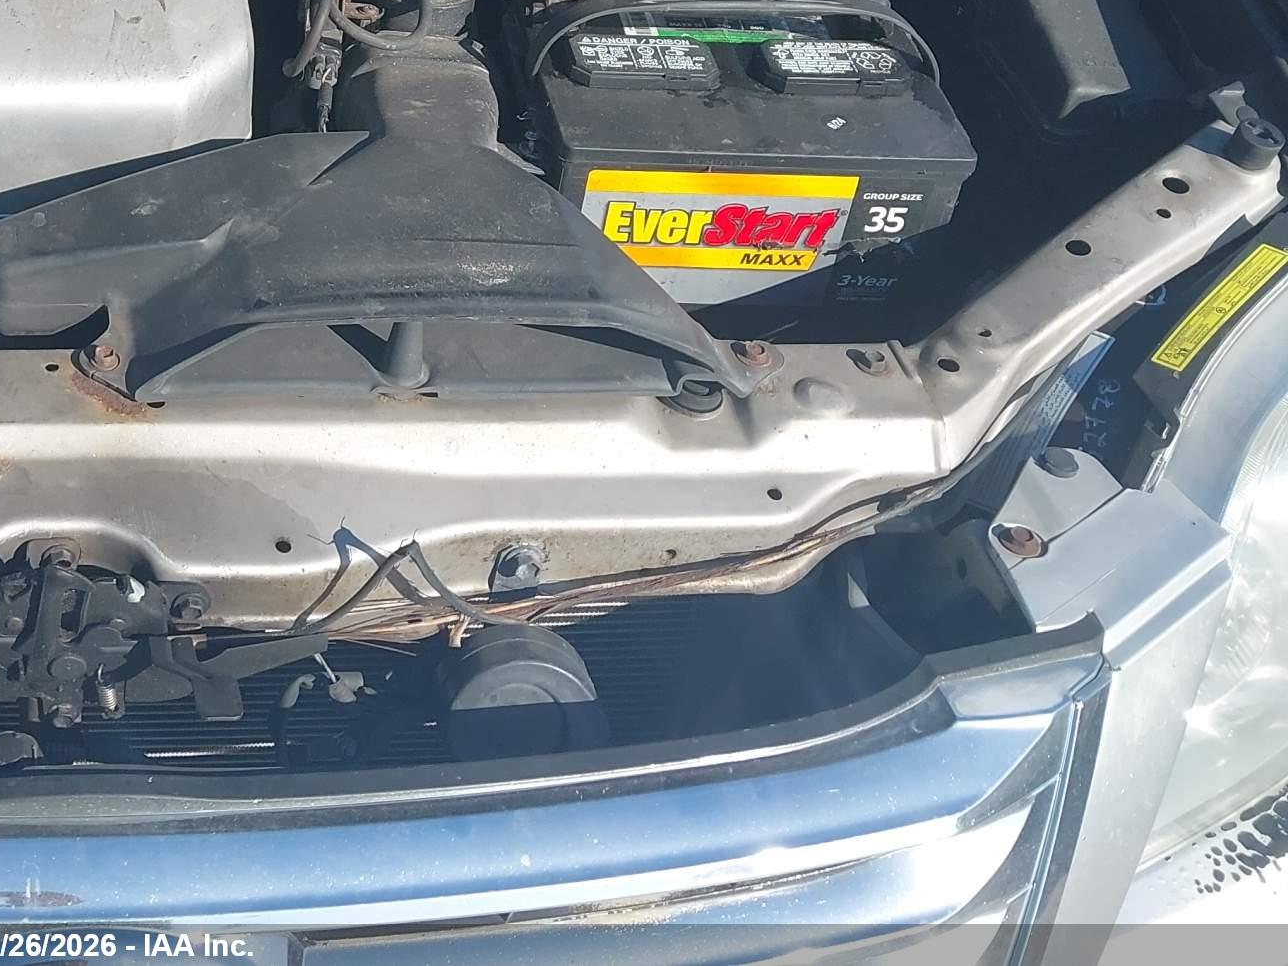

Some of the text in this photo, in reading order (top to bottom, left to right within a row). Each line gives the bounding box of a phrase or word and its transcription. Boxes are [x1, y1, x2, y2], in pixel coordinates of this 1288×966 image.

[592, 36, 638, 45] DANGER
[649, 38, 690, 46] POISON
[863, 192, 923, 201] GROUP SIZE
[603, 201, 842, 247] EverStart
[864, 206, 909, 233] 35
[739, 253, 806, 266] MAXX
[836, 274, 897, 287] 3-Year
